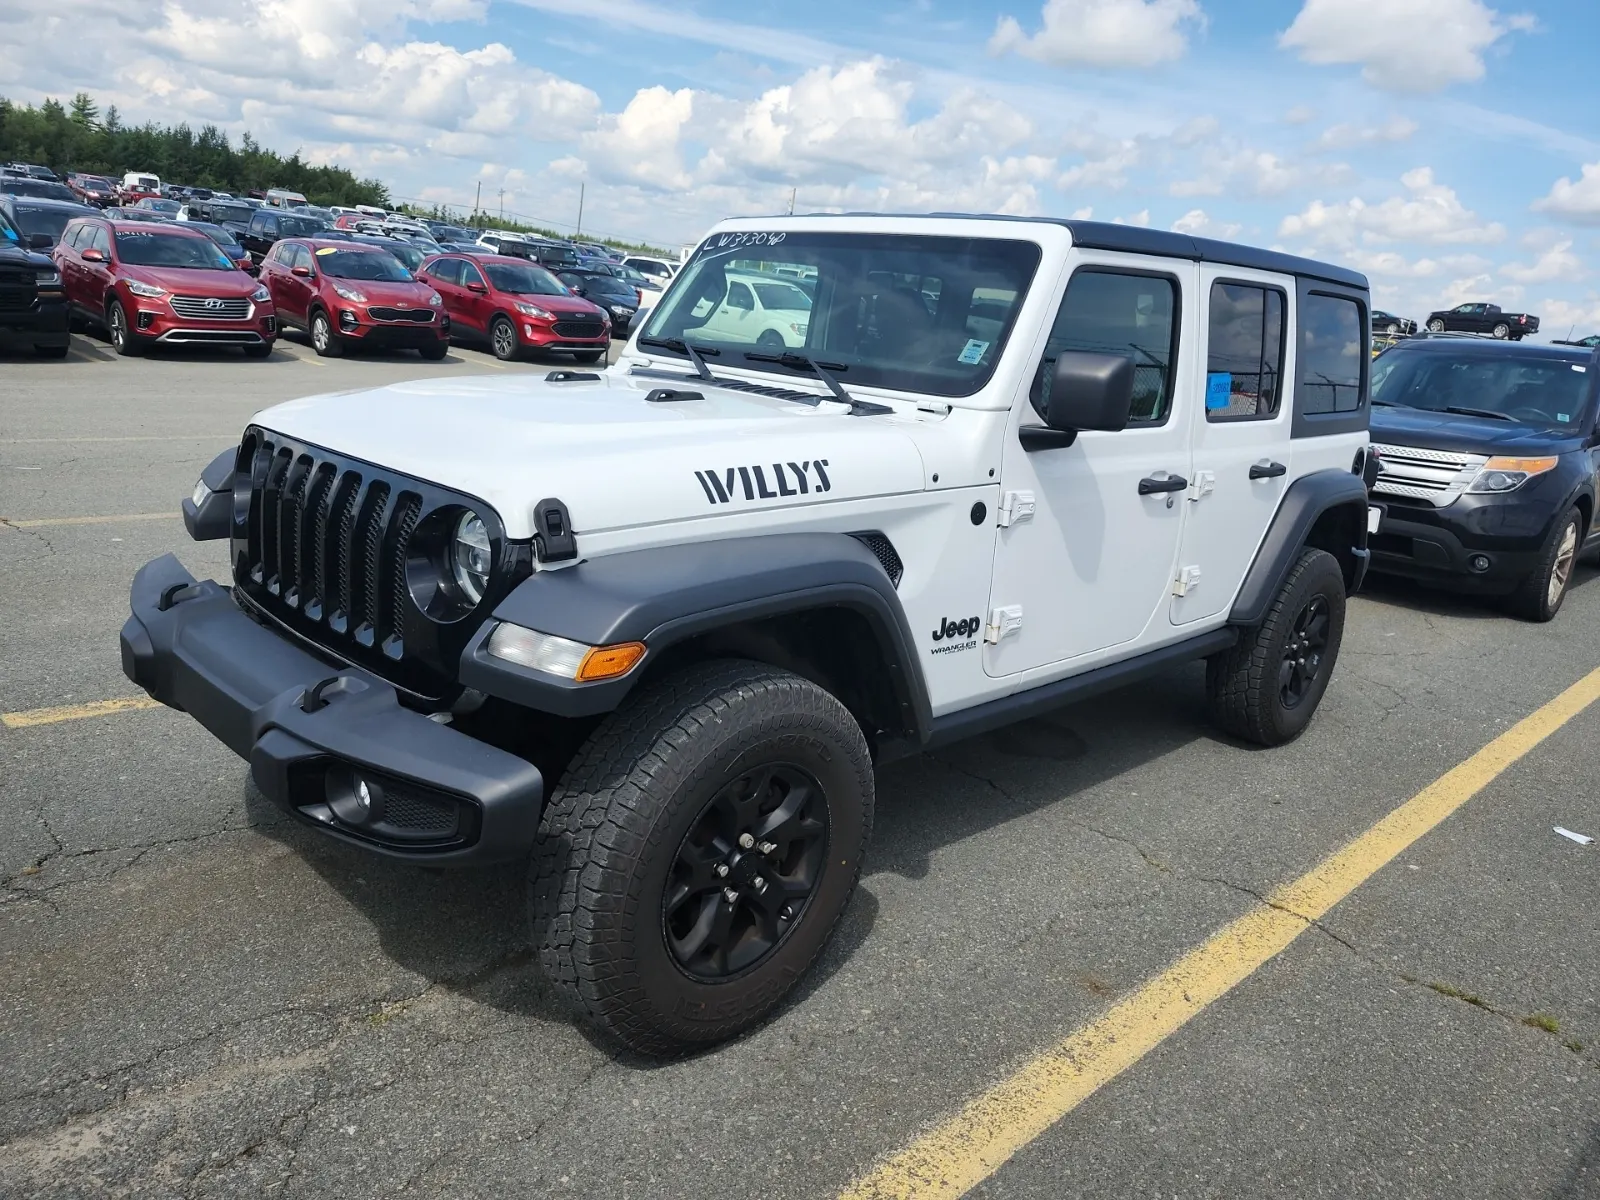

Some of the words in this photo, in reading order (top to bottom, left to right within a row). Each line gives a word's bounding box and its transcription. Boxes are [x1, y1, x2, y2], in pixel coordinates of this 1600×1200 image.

[694, 459, 831, 504] WILLYS
[932, 616, 980, 641] Jeep
[931, 641, 977, 655] WRANGLER
